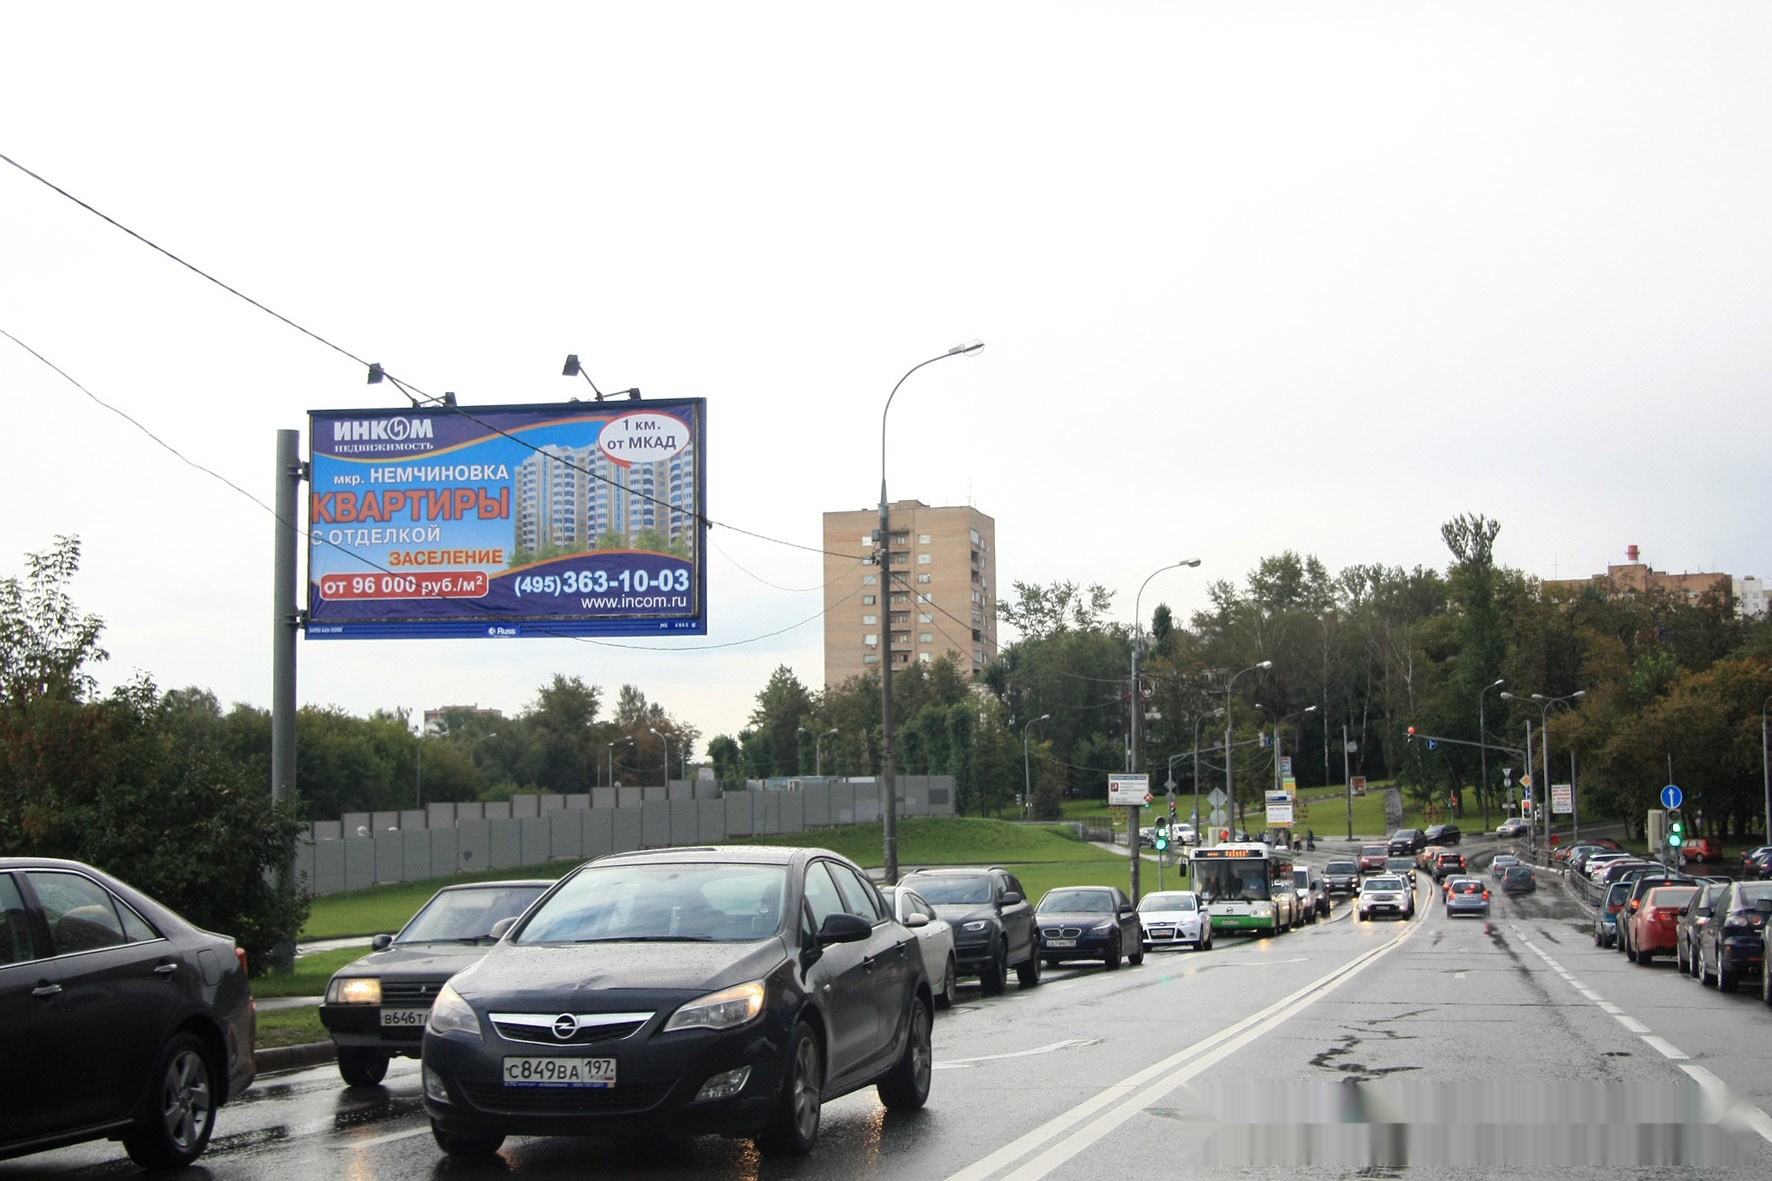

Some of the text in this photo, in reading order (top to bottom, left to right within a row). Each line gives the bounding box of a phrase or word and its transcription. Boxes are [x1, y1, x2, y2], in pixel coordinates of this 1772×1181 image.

[334, 416, 434, 441] ИНКОМ
[623, 419, 661, 431] 1 км.
[334, 442, 434, 453] НЕДВИЖИМОСТЬ
[607, 435, 677, 450] от МКАД
[334, 464, 510, 487] мкр. НЕМЧИНОВКА
[312, 488, 510, 523] КВАРТИРЫ
[328, 525, 441, 546] ОТДЕЛКОЙ
[388, 549, 505, 567] ЗАСЕЛЕНИЕ
[324, 581, 347, 594] от
[352, 577, 375, 594] 96
[381, 575, 417, 593] 000
[581, 594, 687, 609] www.incom.ru
[584, 1060, 612, 1075] 197
